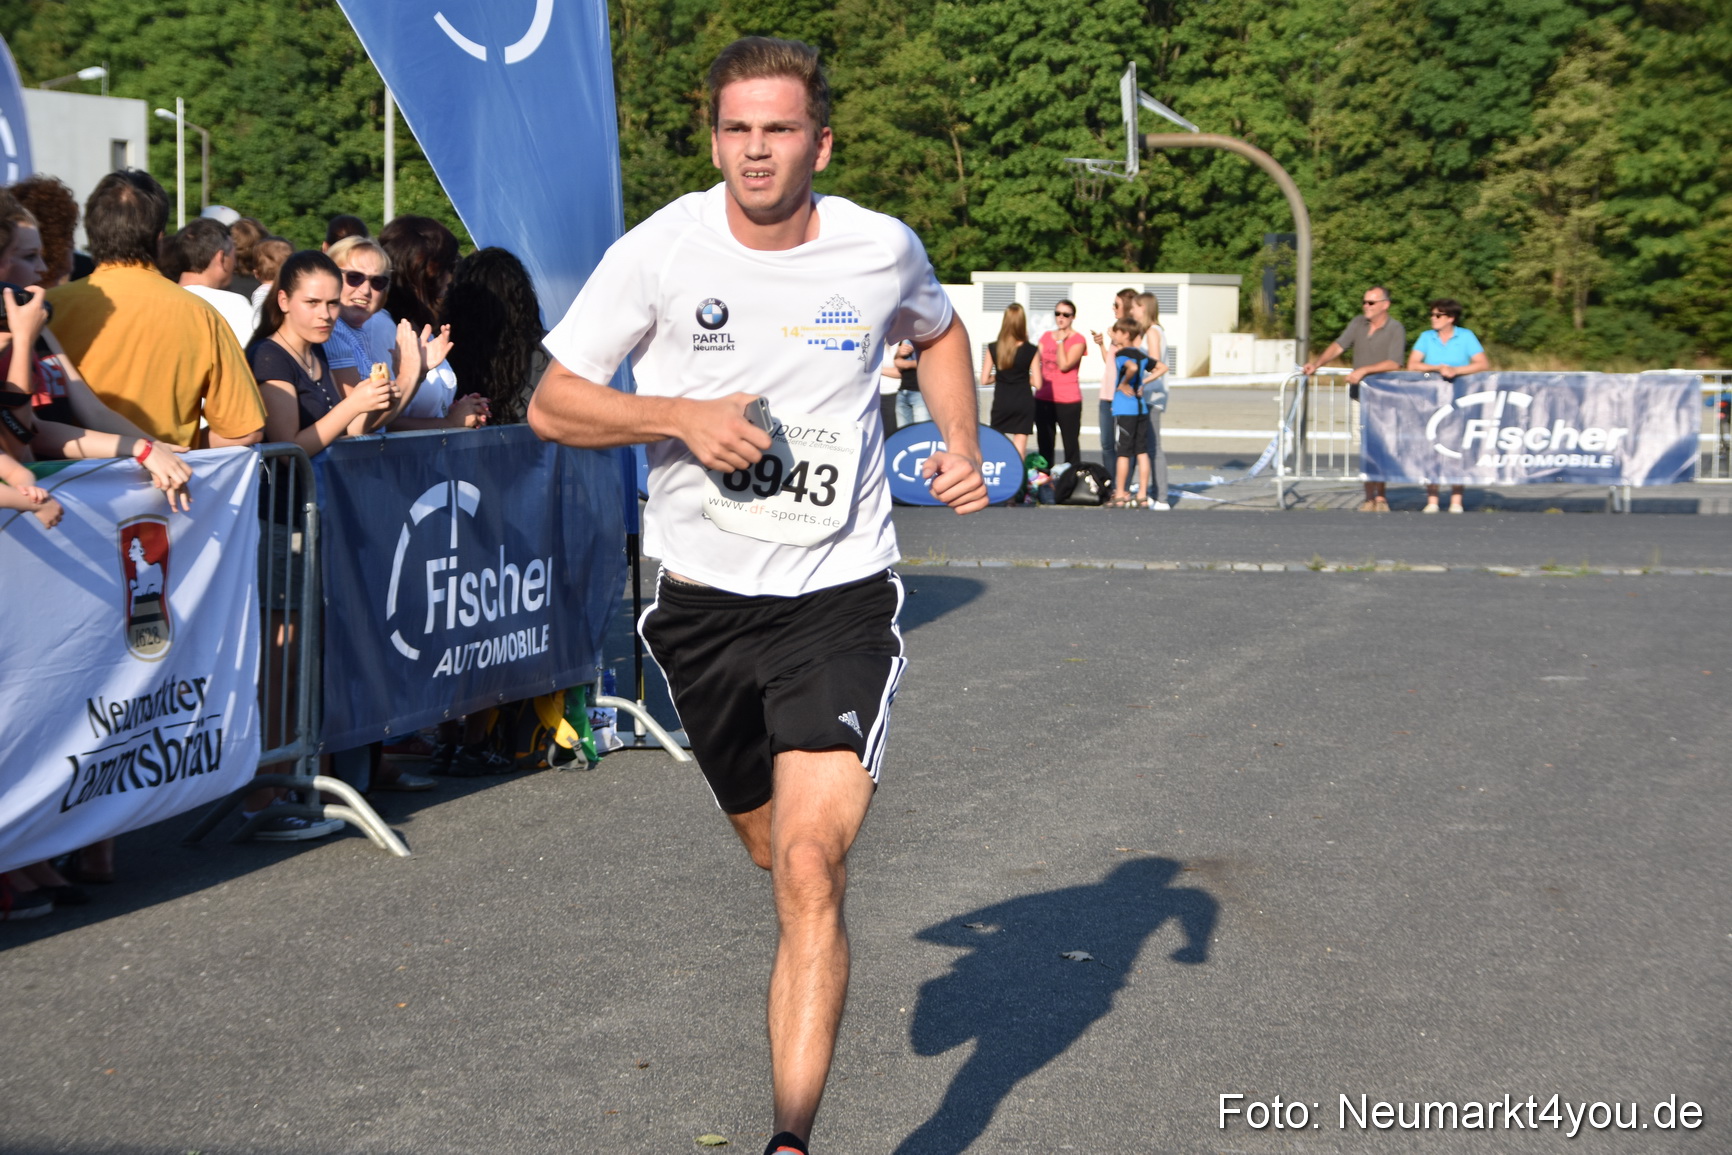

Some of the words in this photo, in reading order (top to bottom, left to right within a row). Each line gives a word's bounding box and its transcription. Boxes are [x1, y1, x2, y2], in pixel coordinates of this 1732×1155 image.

[692, 333, 735, 343] PARTL
[693, 343, 735, 351] Neumarkt
[772, 422, 840, 444] ports
[1462, 419, 1628, 451] Fischer
[775, 436, 808, 447] moderne
[809, 441, 855, 454] Zeitmessung
[1477, 454, 1614, 468] AUTOMOBILE
[708, 497, 841, 528] www.df-sports.de
[135, 626, 161, 649] 1628
[432, 624, 550, 678] AUTOMOBILE
[86, 674, 207, 738] Neumarkter
[59, 717, 223, 813] Lammsbräu
